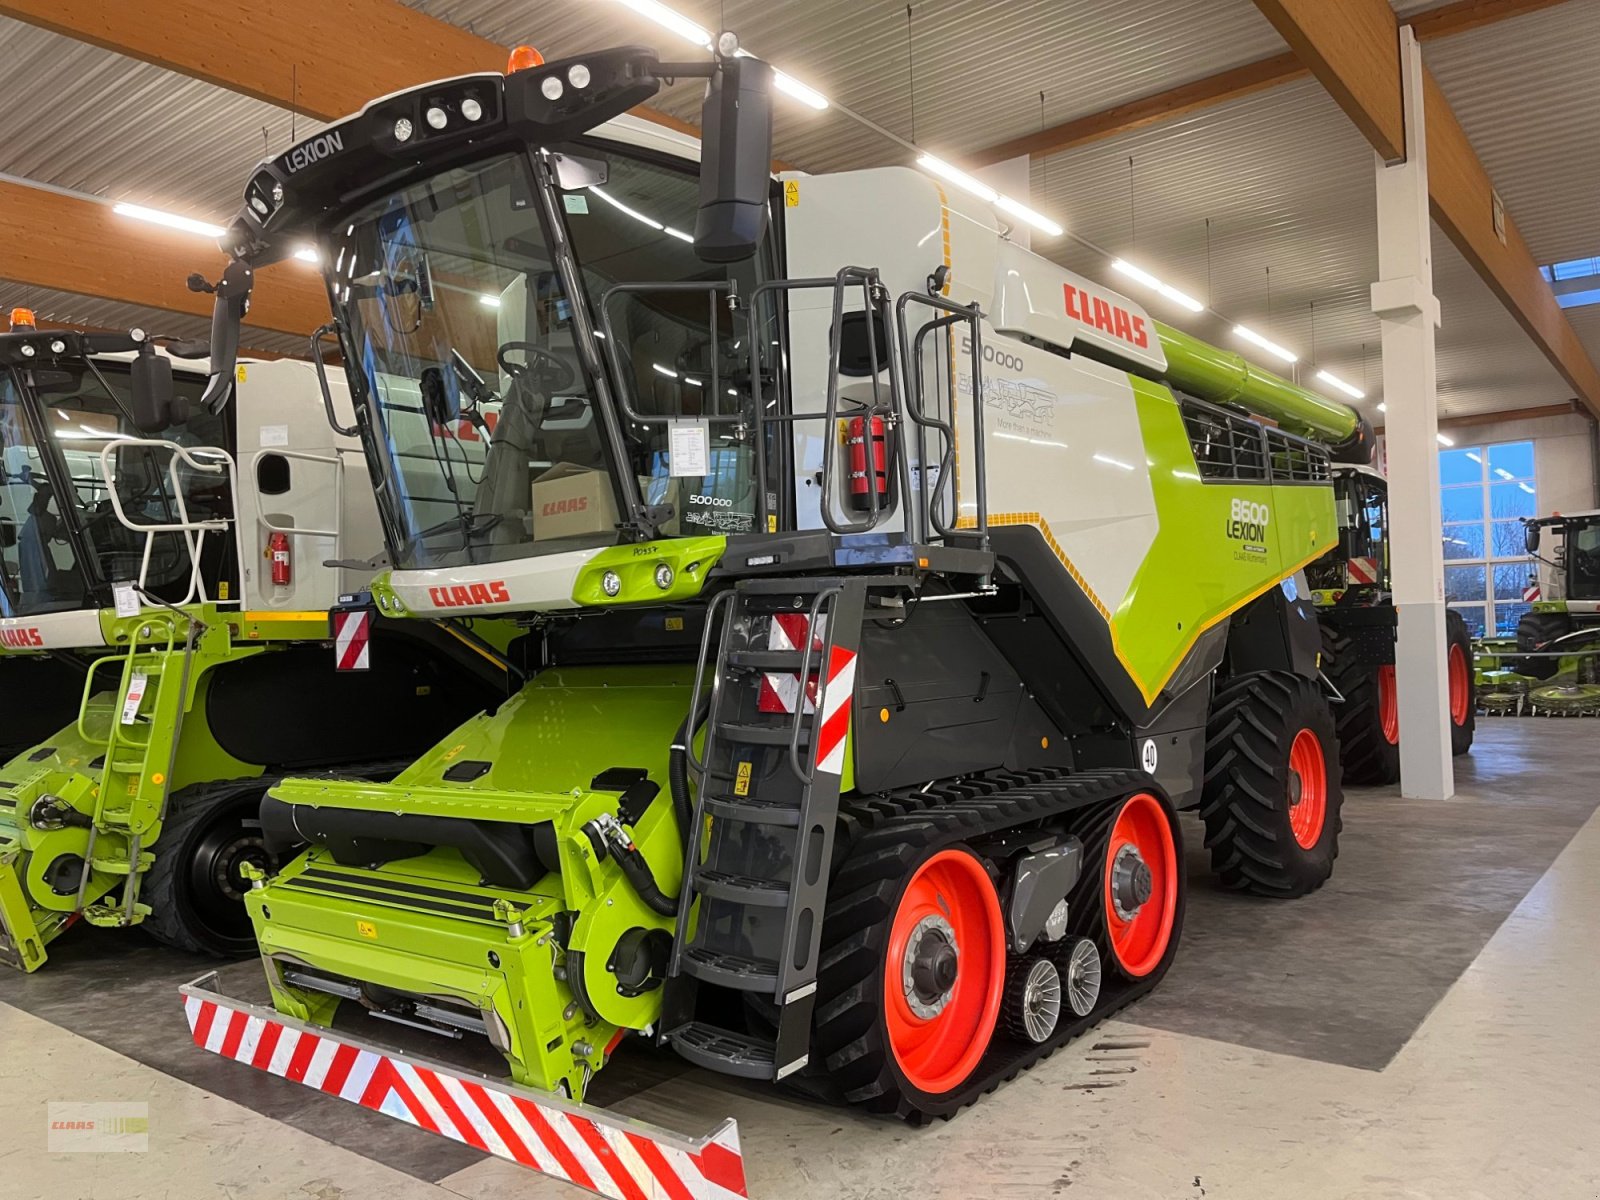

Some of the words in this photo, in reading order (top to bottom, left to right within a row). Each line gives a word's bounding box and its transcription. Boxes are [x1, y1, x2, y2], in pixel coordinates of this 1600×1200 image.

[285, 131, 344, 173] LEXION
[1063, 283, 1148, 349] CLAAS
[543, 496, 588, 517] CLAAS
[1231, 498, 1269, 526] 8600
[1227, 519, 1264, 543] LEXION
[428, 581, 511, 607] CLAAS
[0, 628, 43, 646] LAAS
[1145, 745, 1154, 768] 40
